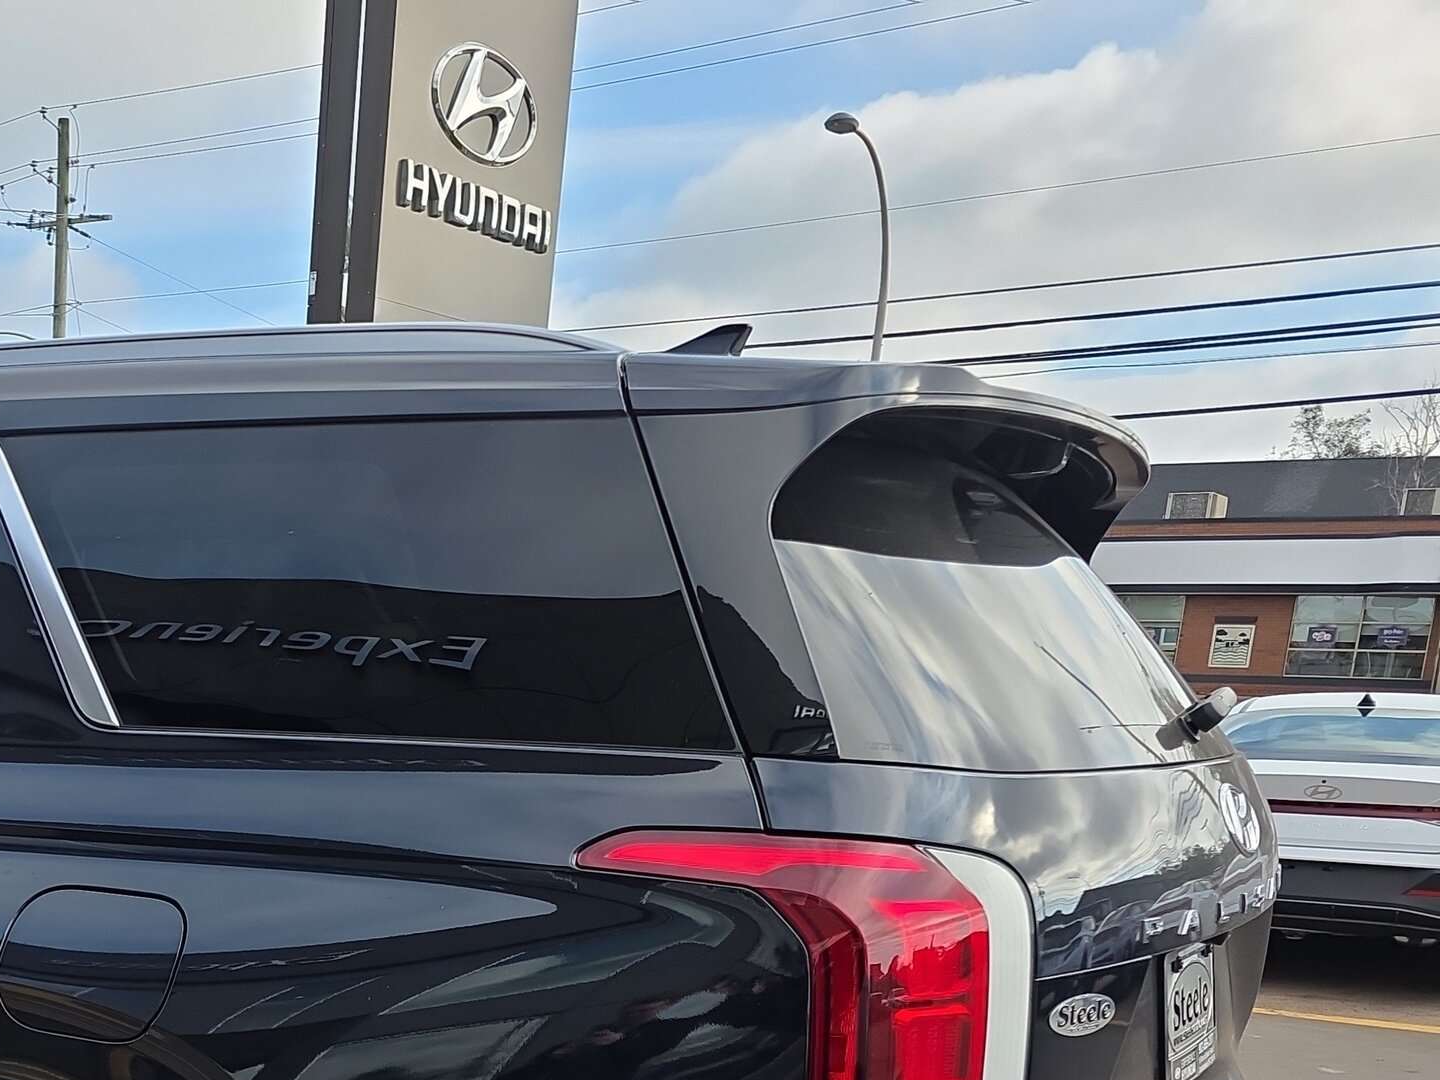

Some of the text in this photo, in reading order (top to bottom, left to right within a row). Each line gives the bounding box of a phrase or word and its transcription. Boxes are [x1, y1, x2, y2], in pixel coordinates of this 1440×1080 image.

[396, 158, 551, 254] HYUNDAI
[1057, 1000, 1111, 1028] Steele
[1173, 976, 1209, 1031] Steele
